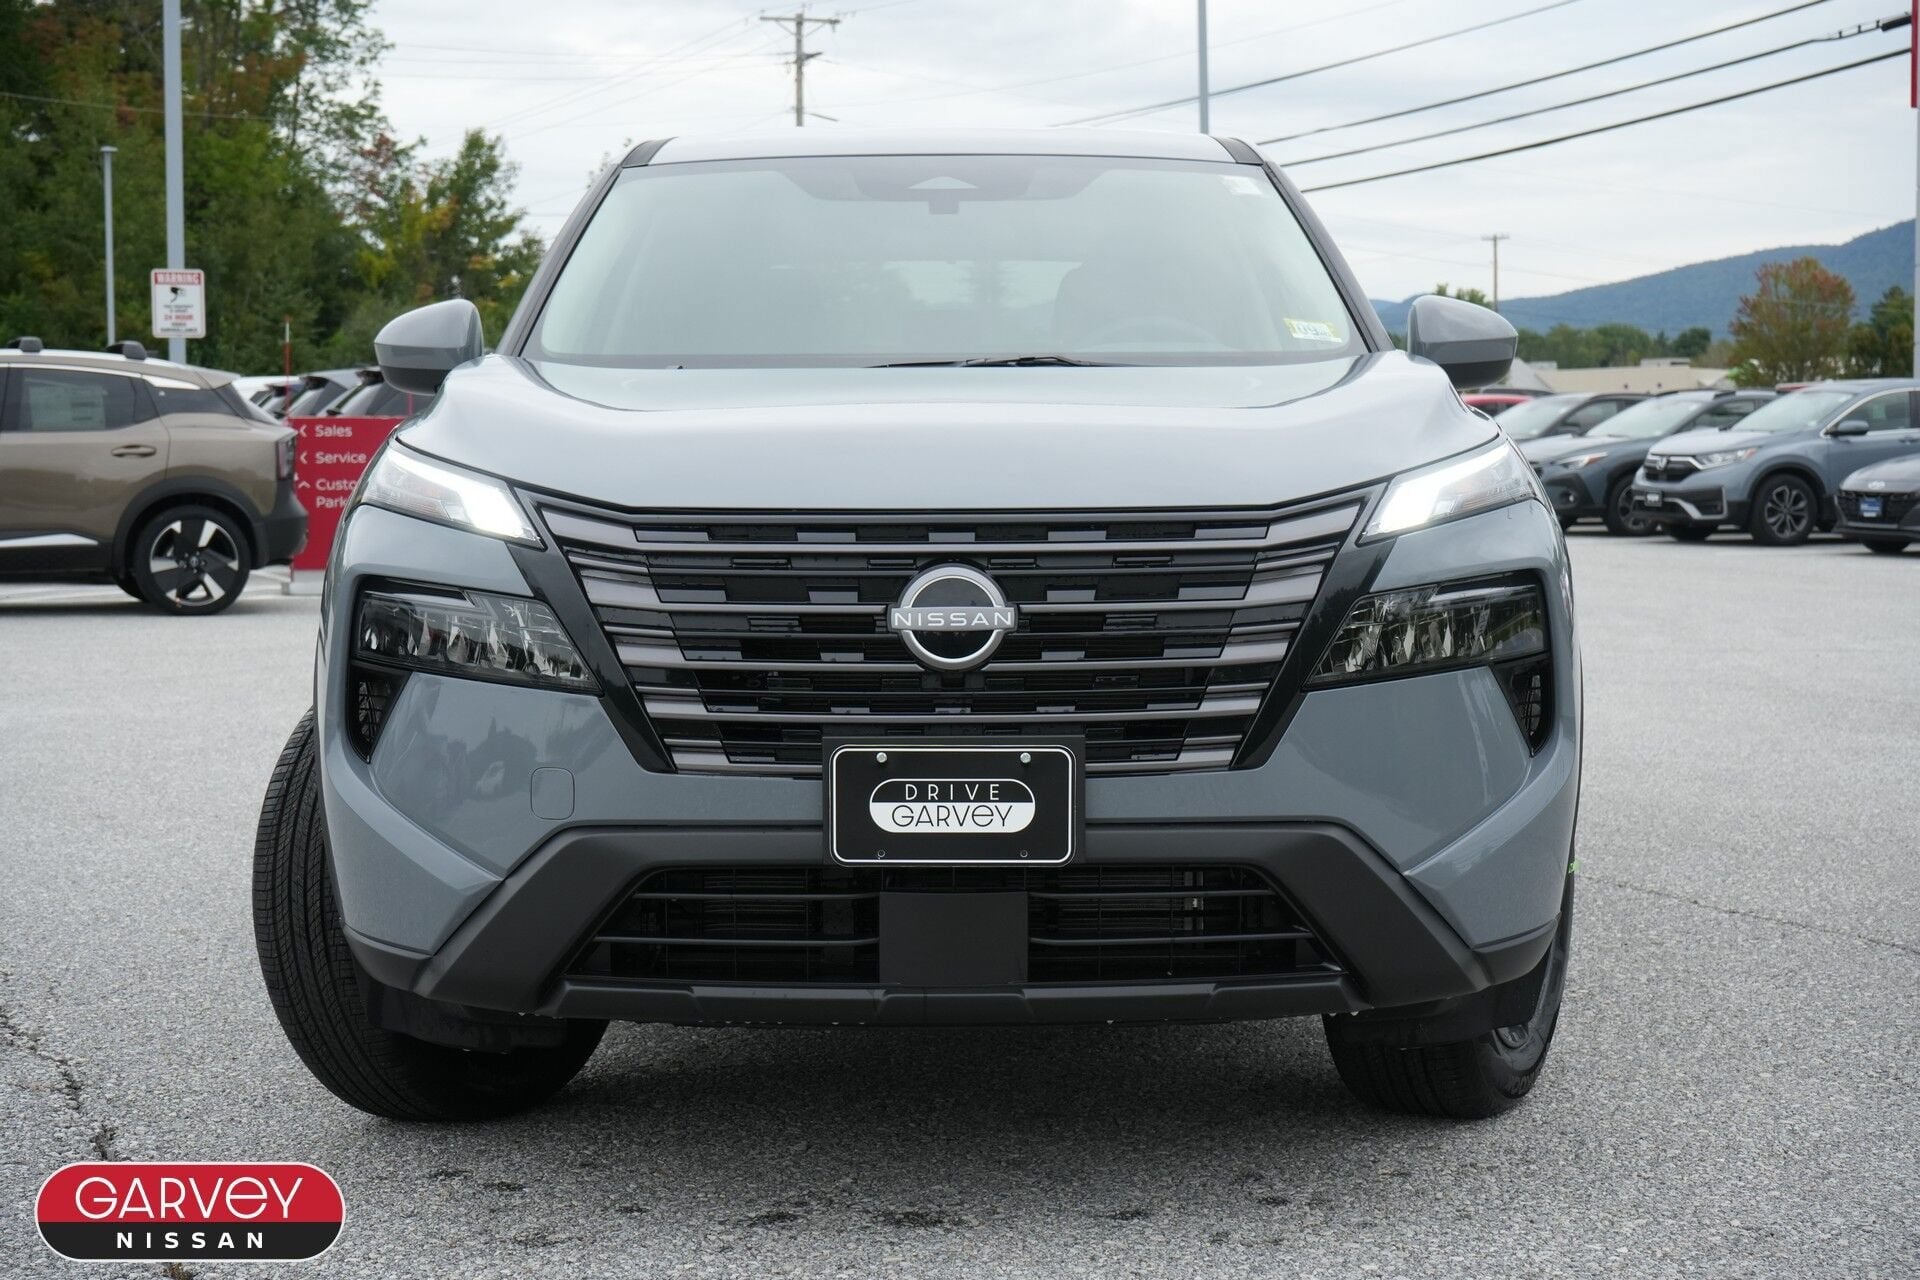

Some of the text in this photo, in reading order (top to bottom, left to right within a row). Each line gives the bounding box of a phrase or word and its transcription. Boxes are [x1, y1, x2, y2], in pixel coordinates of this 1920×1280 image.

[157, 273, 199, 284] WARNING
[315, 425, 353, 437] Sales
[315, 451, 367, 464] Service
[894, 611, 1012, 626] NISSAN
[905, 783, 1000, 800] DRIVE
